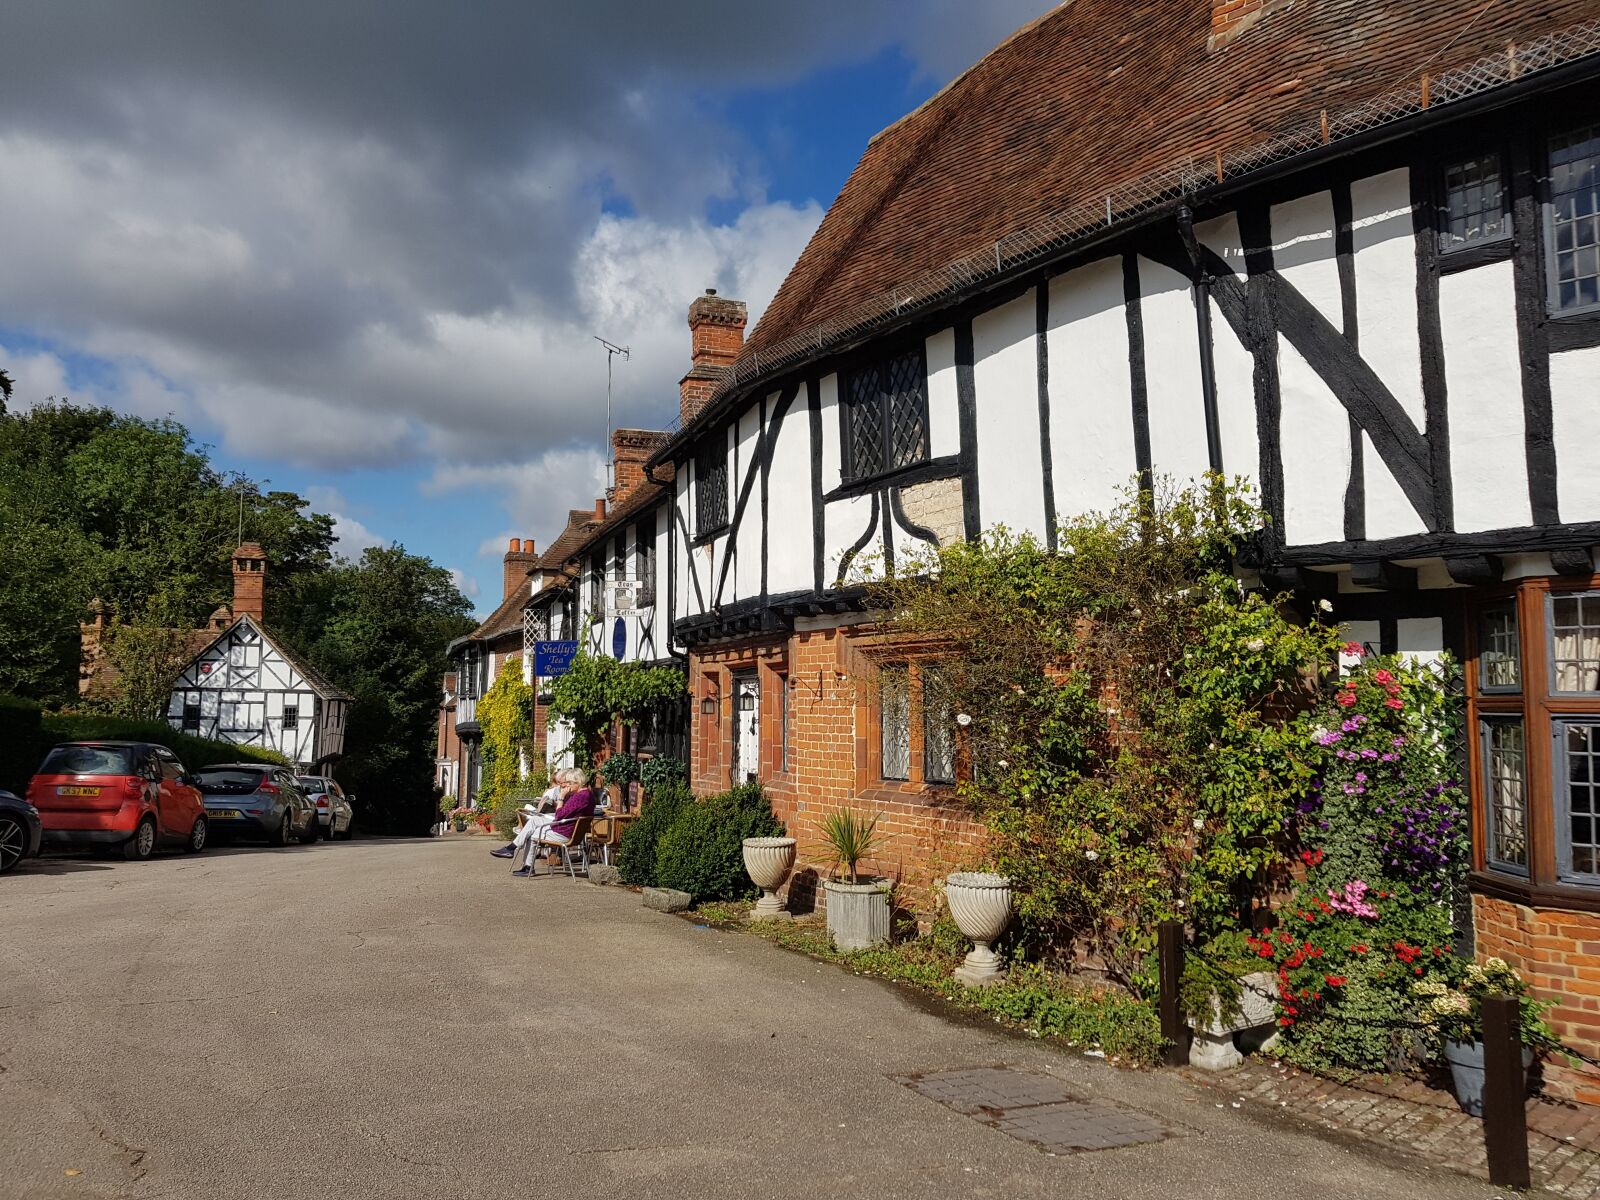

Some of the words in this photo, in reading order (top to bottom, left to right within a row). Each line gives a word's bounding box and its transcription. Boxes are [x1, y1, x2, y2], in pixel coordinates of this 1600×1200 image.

[538, 643, 577, 656] Shelly's
[548, 655, 564, 664] Tea
[544, 664, 573, 674] Rooms
